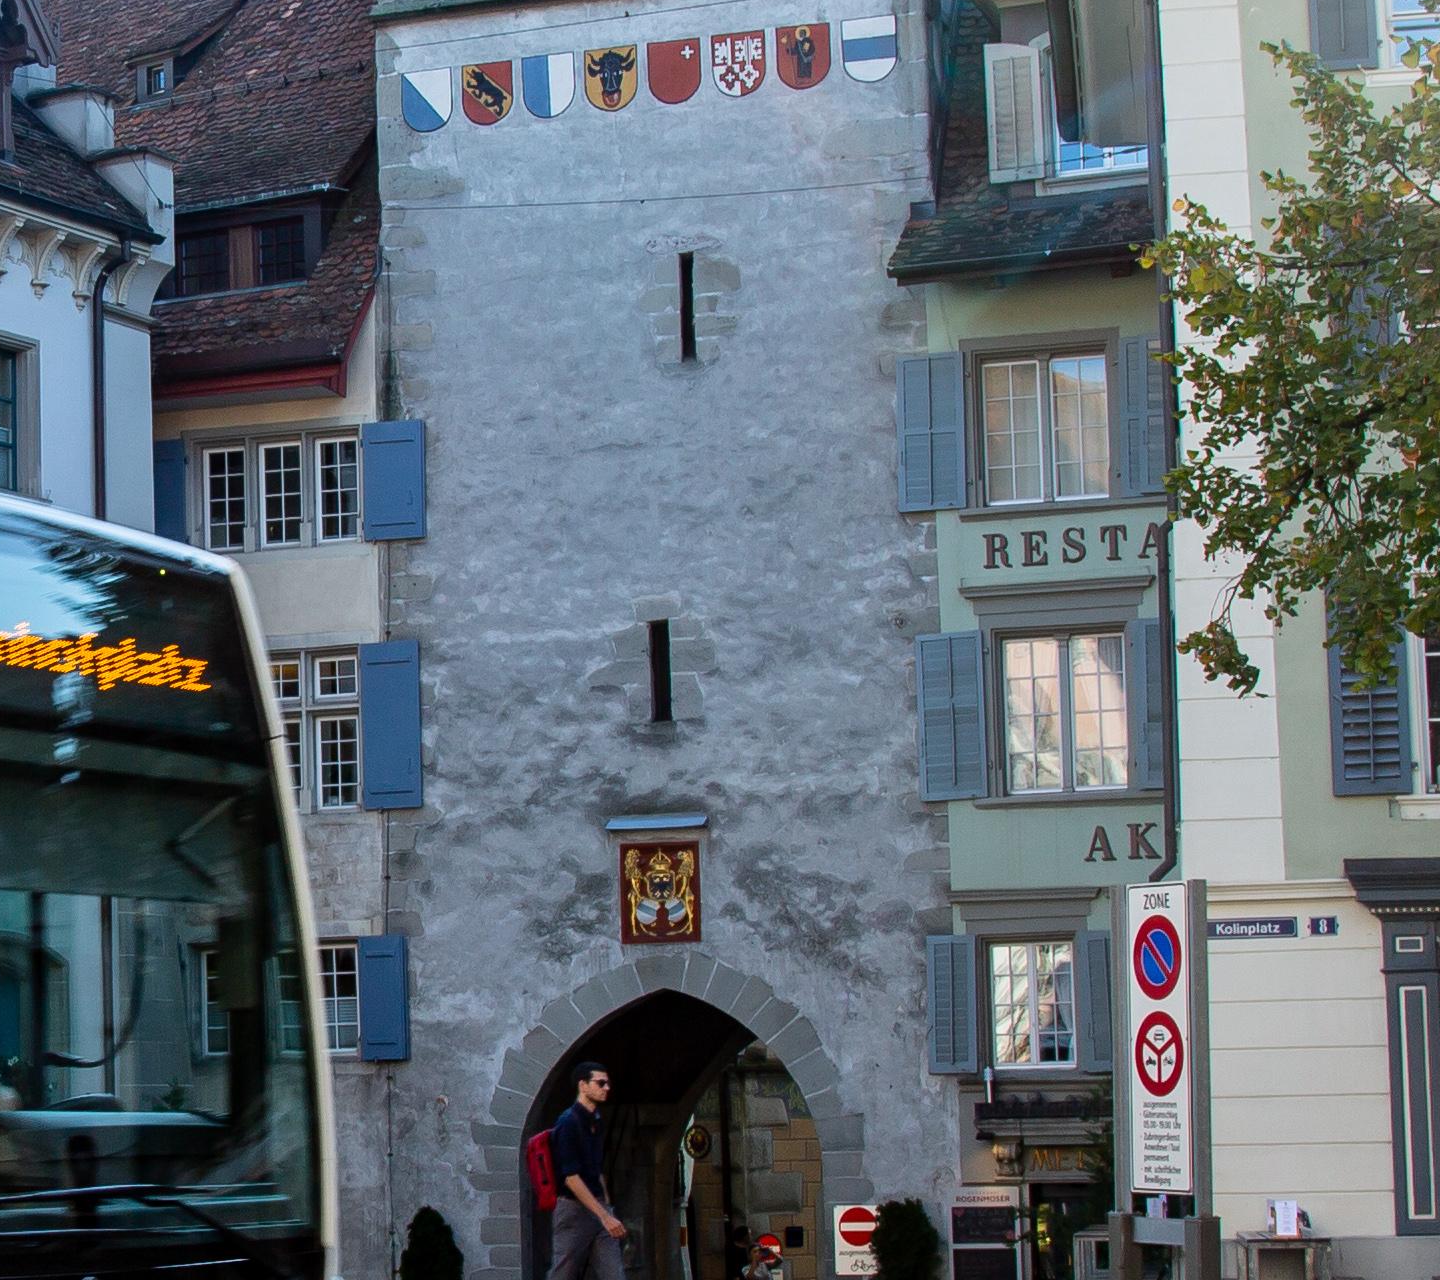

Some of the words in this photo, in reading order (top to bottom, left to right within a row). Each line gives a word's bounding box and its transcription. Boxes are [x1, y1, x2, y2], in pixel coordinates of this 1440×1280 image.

[1143, 892, 1170, 910] ZONE
[1216, 922, 1280, 937] Kolinplatz
[1319, 918, 1328, 933] 8
[956, 1195, 1010, 1203] ROGENMOSER
